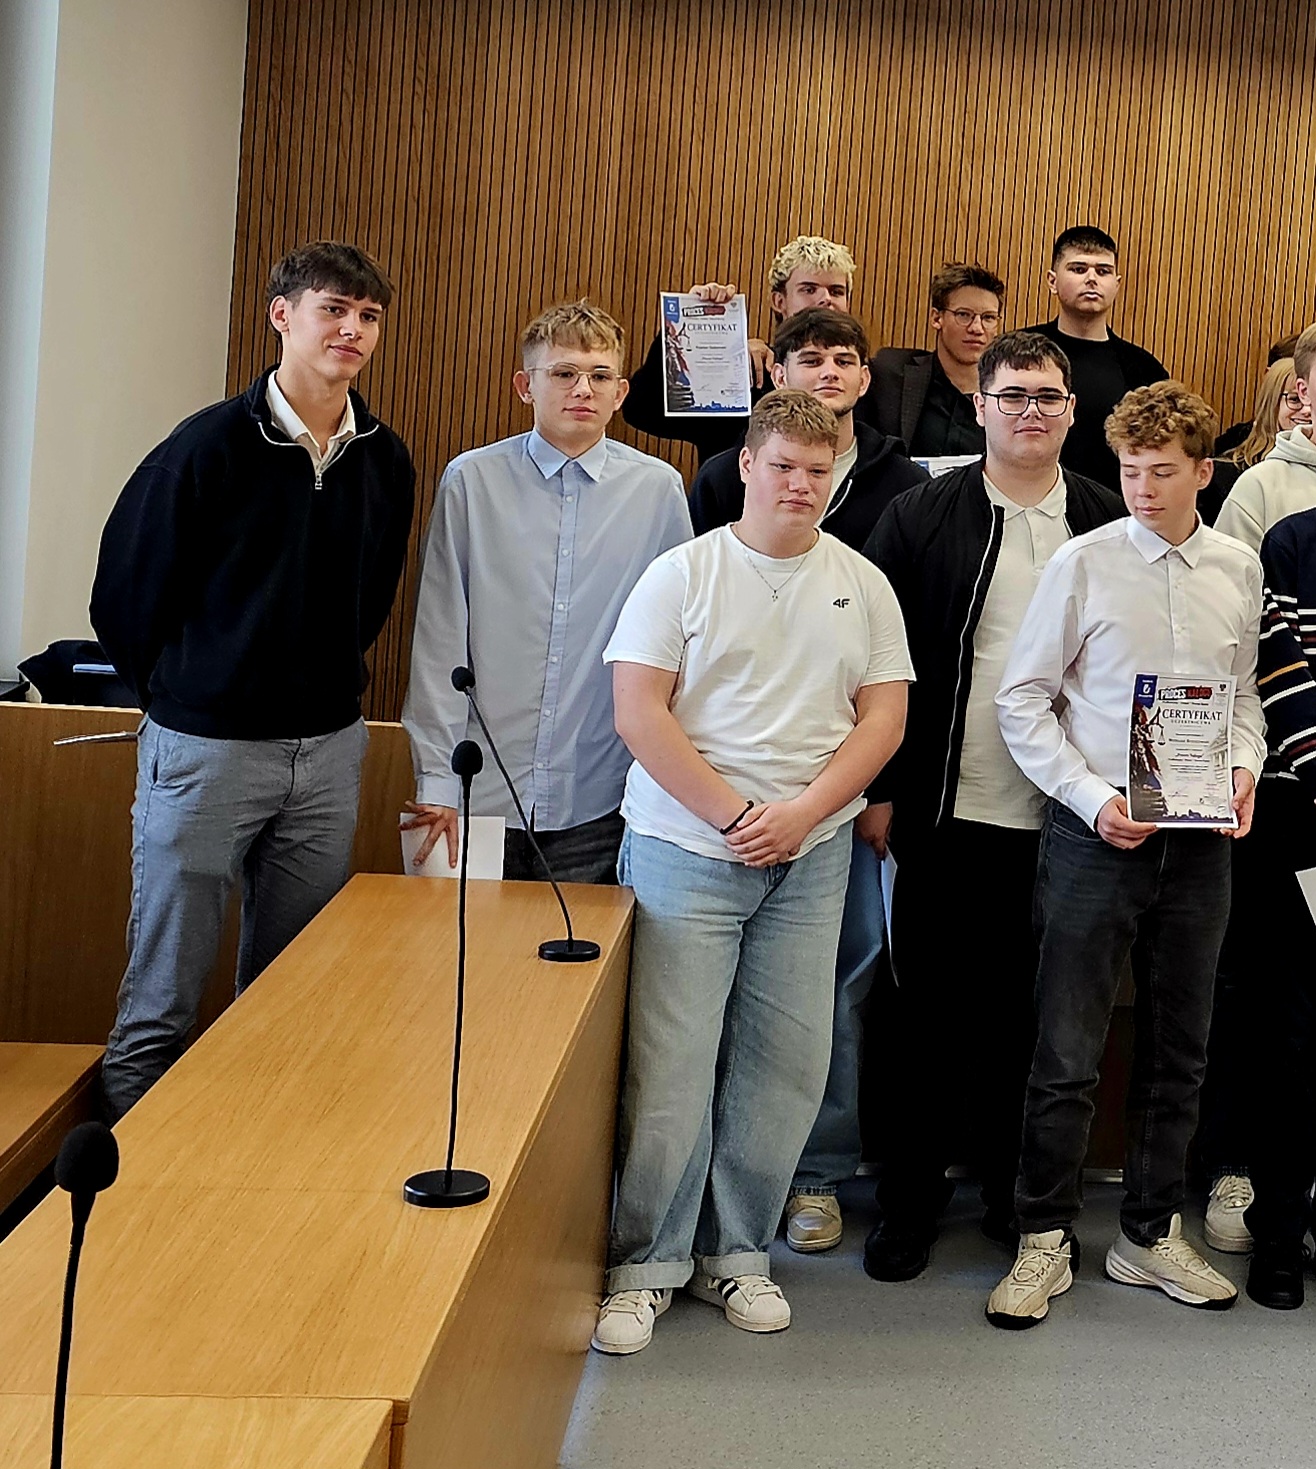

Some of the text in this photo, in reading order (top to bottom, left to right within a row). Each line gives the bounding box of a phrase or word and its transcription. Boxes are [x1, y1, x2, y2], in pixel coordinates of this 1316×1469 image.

[687, 323, 737, 331] CERTYFIKAT
[832, 598, 851, 609] 4F
[1160, 689, 1186, 699] PROCES
[1162, 708, 1222, 721] CERTYFIKAT
